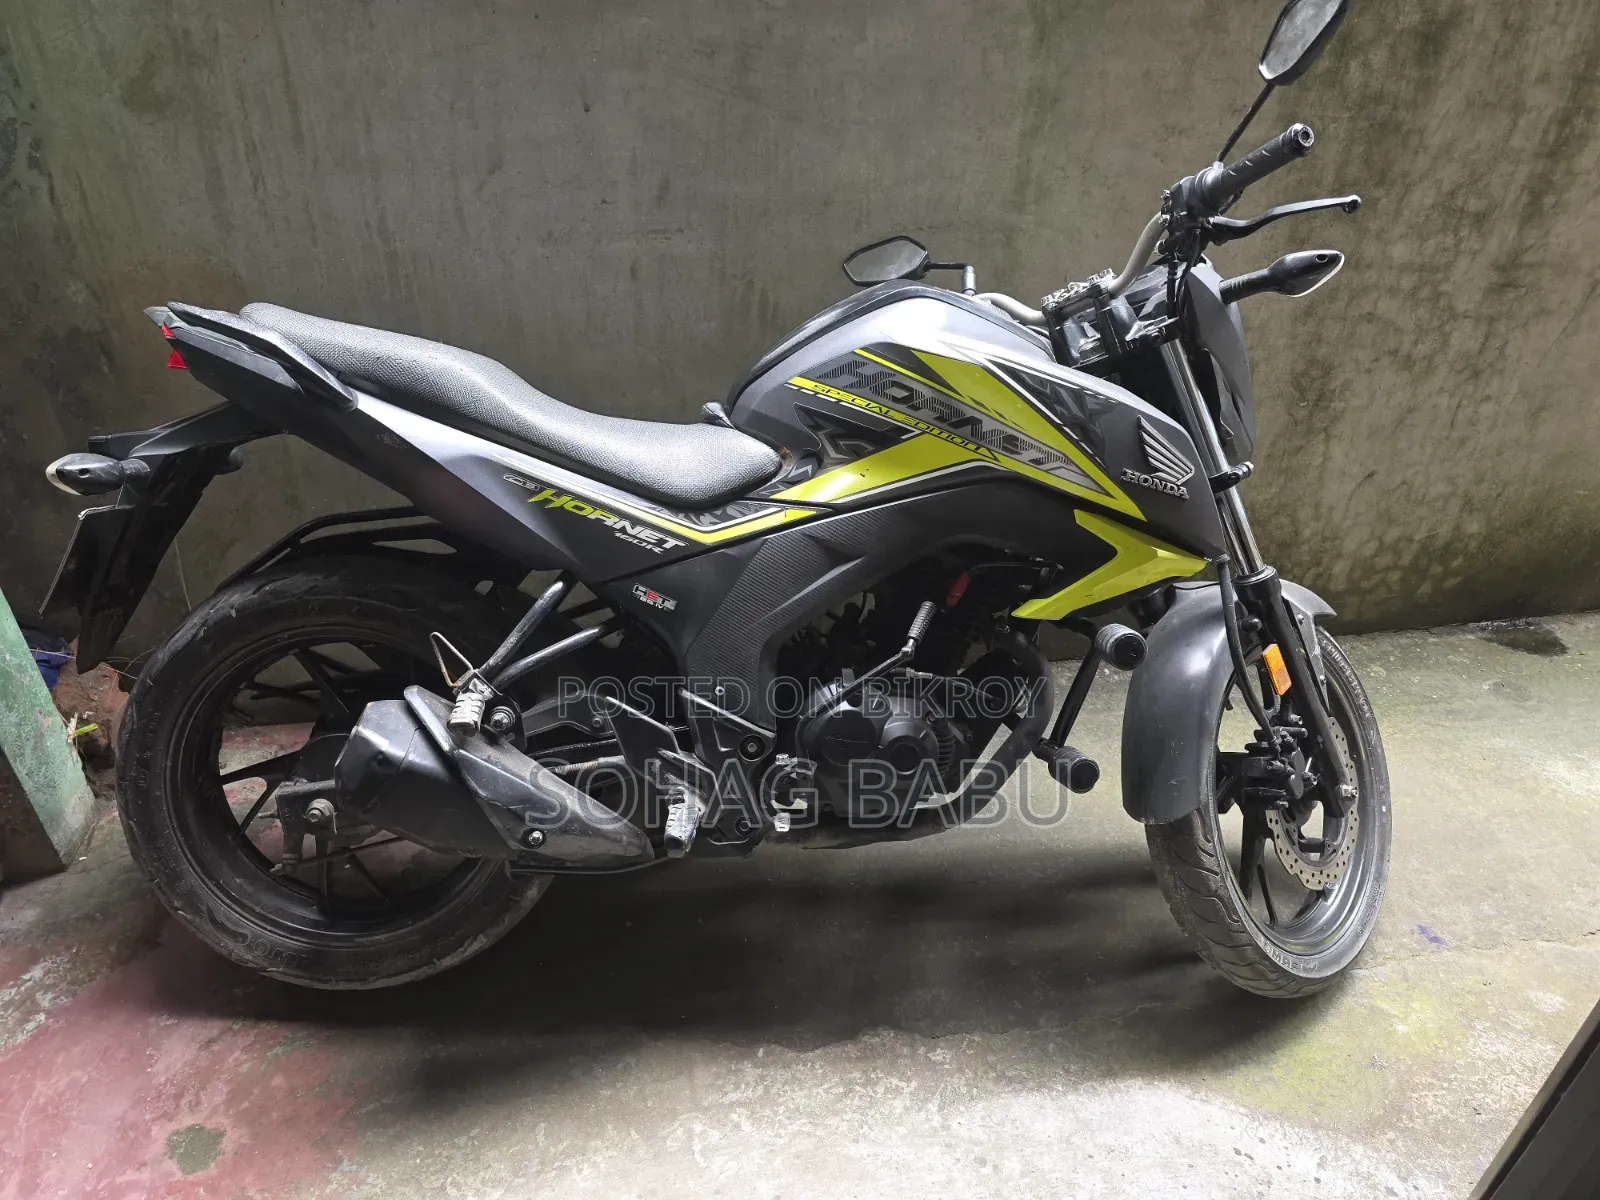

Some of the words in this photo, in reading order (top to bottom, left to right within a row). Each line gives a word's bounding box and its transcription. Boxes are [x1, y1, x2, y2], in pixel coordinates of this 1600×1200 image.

[811, 384, 894, 419] SPECIAL
[902, 416, 983, 452] EDITION
[1120, 468, 1190, 500] HONDA
[528, 488, 690, 550] HORNET
[614, 530, 664, 555] 160R
